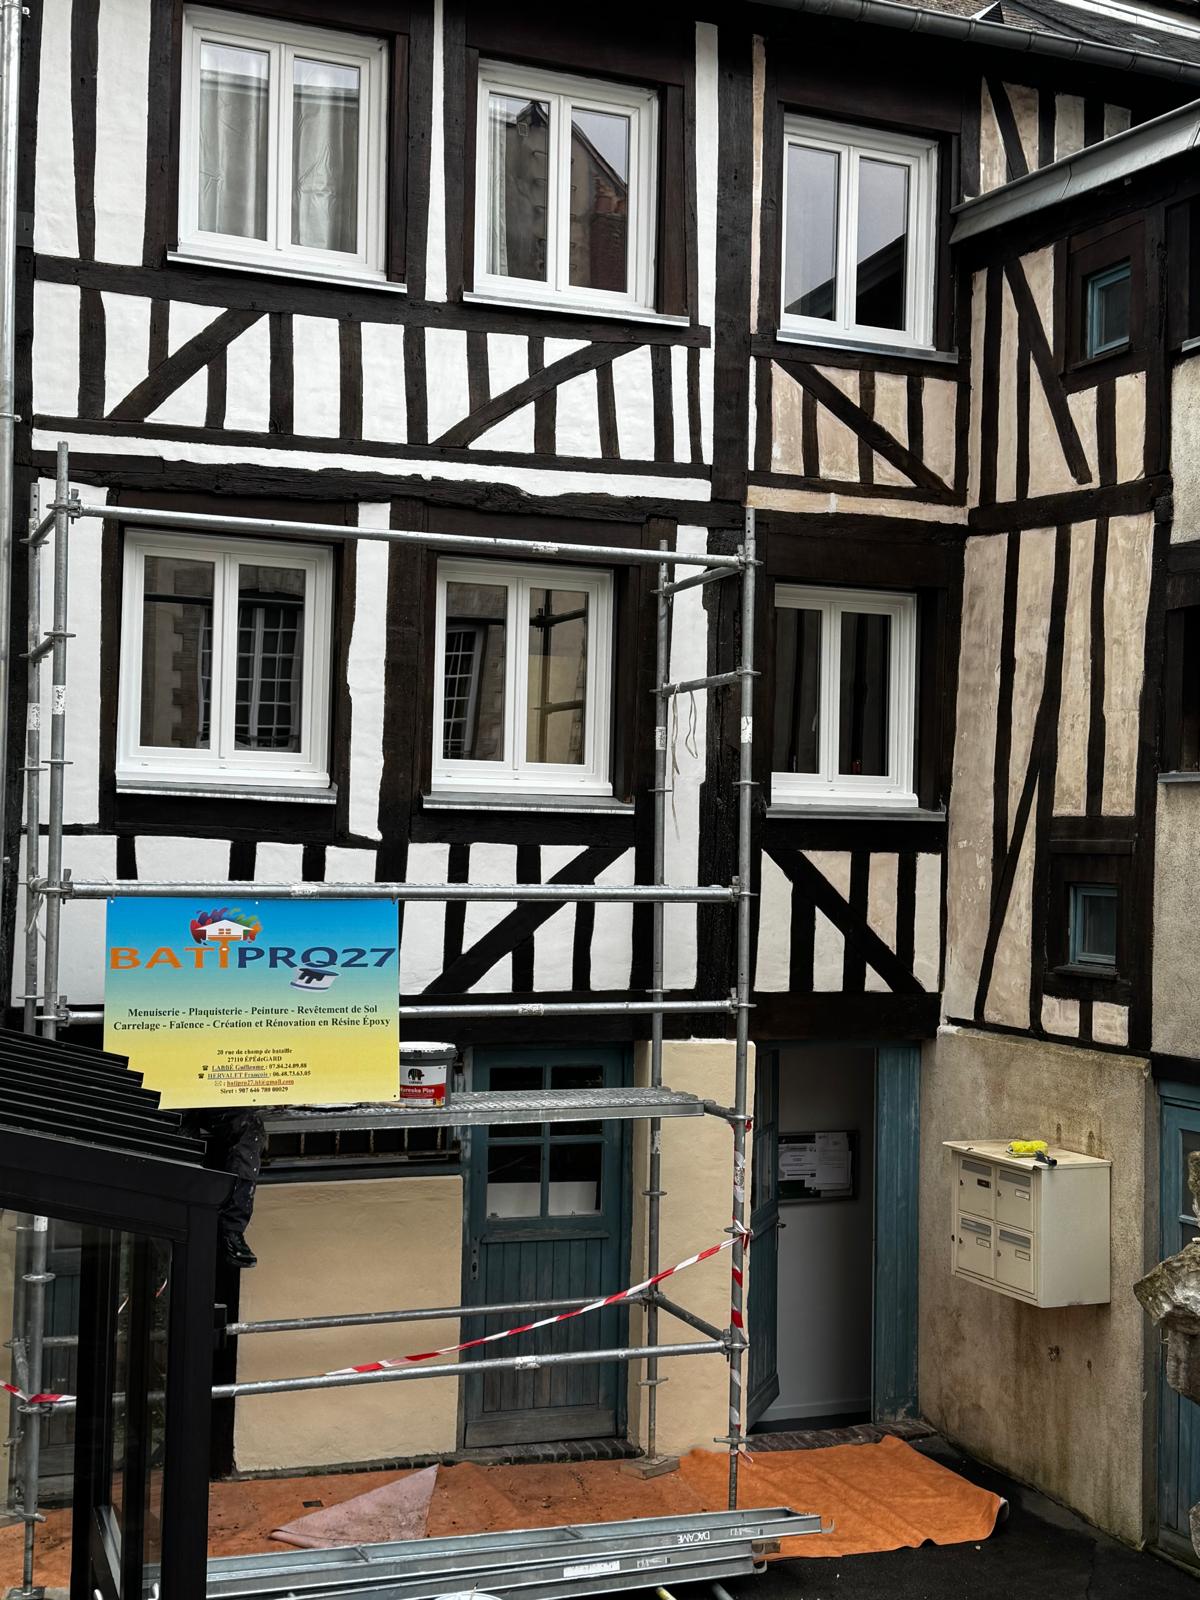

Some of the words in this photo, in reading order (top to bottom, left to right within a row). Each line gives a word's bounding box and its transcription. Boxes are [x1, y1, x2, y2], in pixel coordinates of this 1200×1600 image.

[128, 1007, 180, 1017] Menuiserie
[188, 1007, 243, 1018] Plaquisterie
[251, 1006, 289, 1015] Peinture
[297, 1005, 349, 1014] Revêtement
[351, 1005, 361, 1013] de
[363, 1004, 378, 1013] Sol
[113, 1021, 161, 1031] Carrelage
[169, 1020, 205, 1029] Faïence
[212, 1019, 252, 1028] Création
[254, 1019, 263, 1027] et
[265, 1018, 316, 1027] Rénovation
[331, 1017, 360, 1026] Résine
[363, 1015, 391, 1027] Époxy
